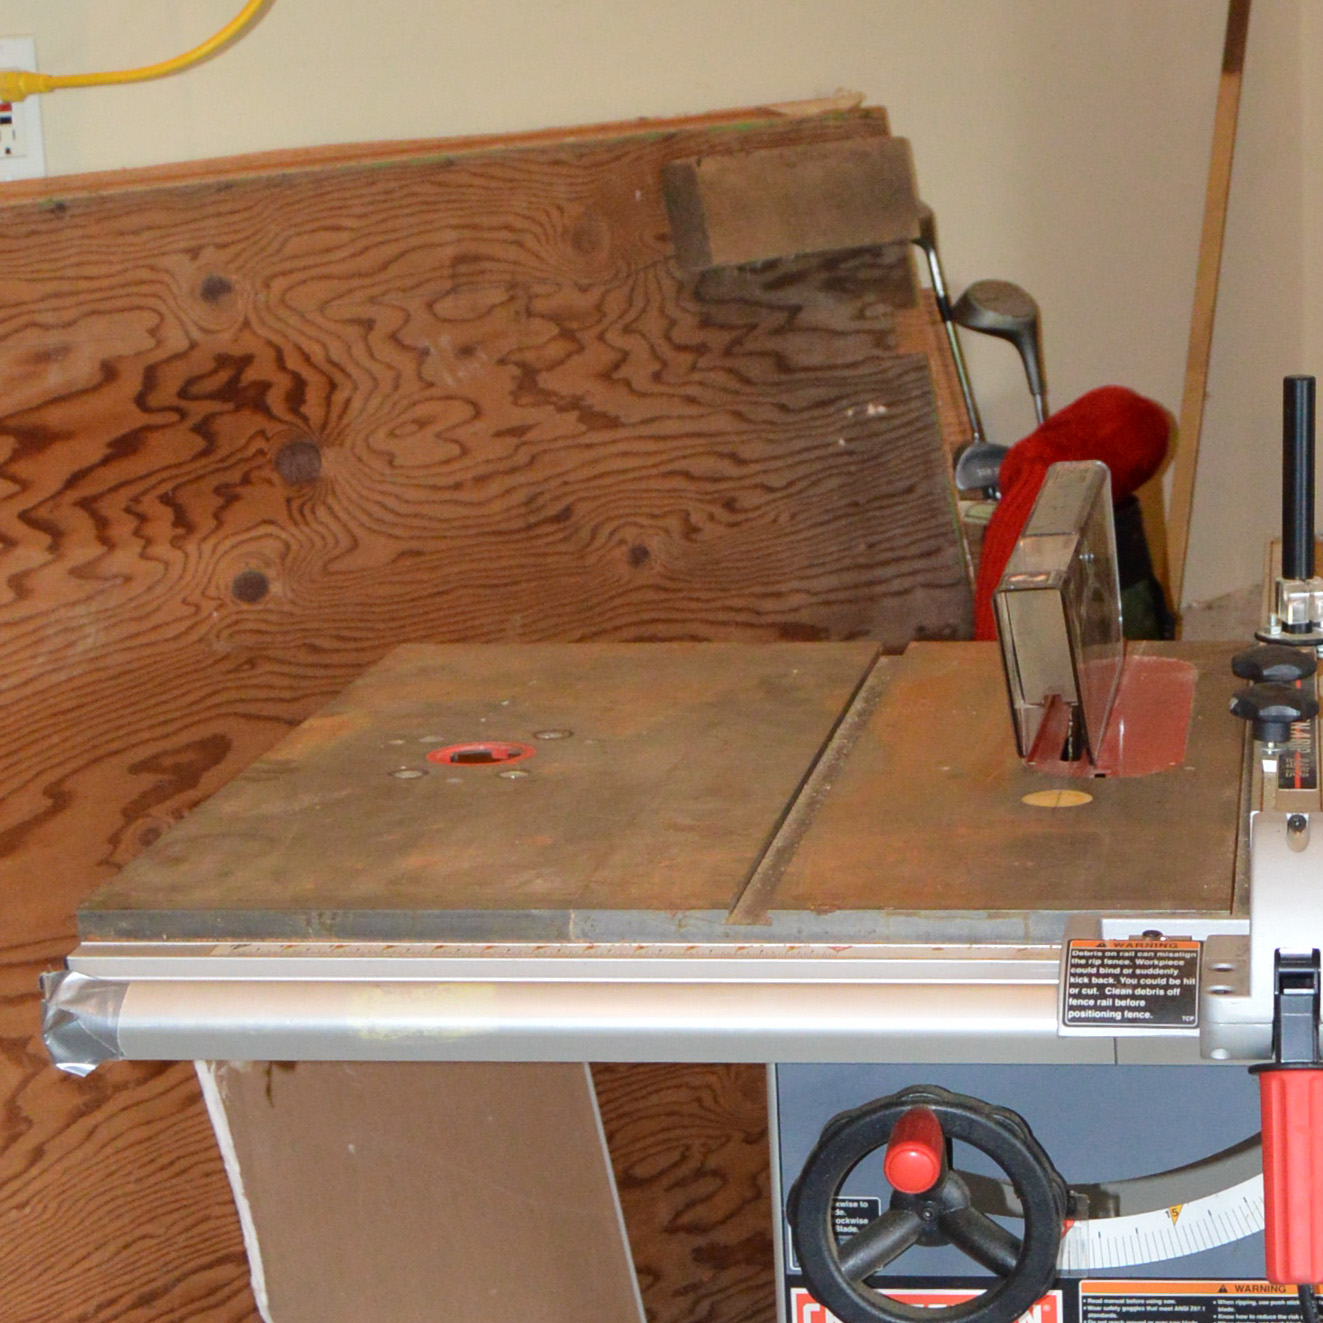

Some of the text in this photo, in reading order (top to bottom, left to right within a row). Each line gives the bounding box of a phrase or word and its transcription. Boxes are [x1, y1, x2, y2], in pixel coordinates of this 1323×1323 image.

[1156, 950, 1198, 958] misalign
[1105, 987, 1133, 995] Clean
[1068, 1010, 1122, 1020] positioning
[1235, 1284, 1286, 1293] WARNING
